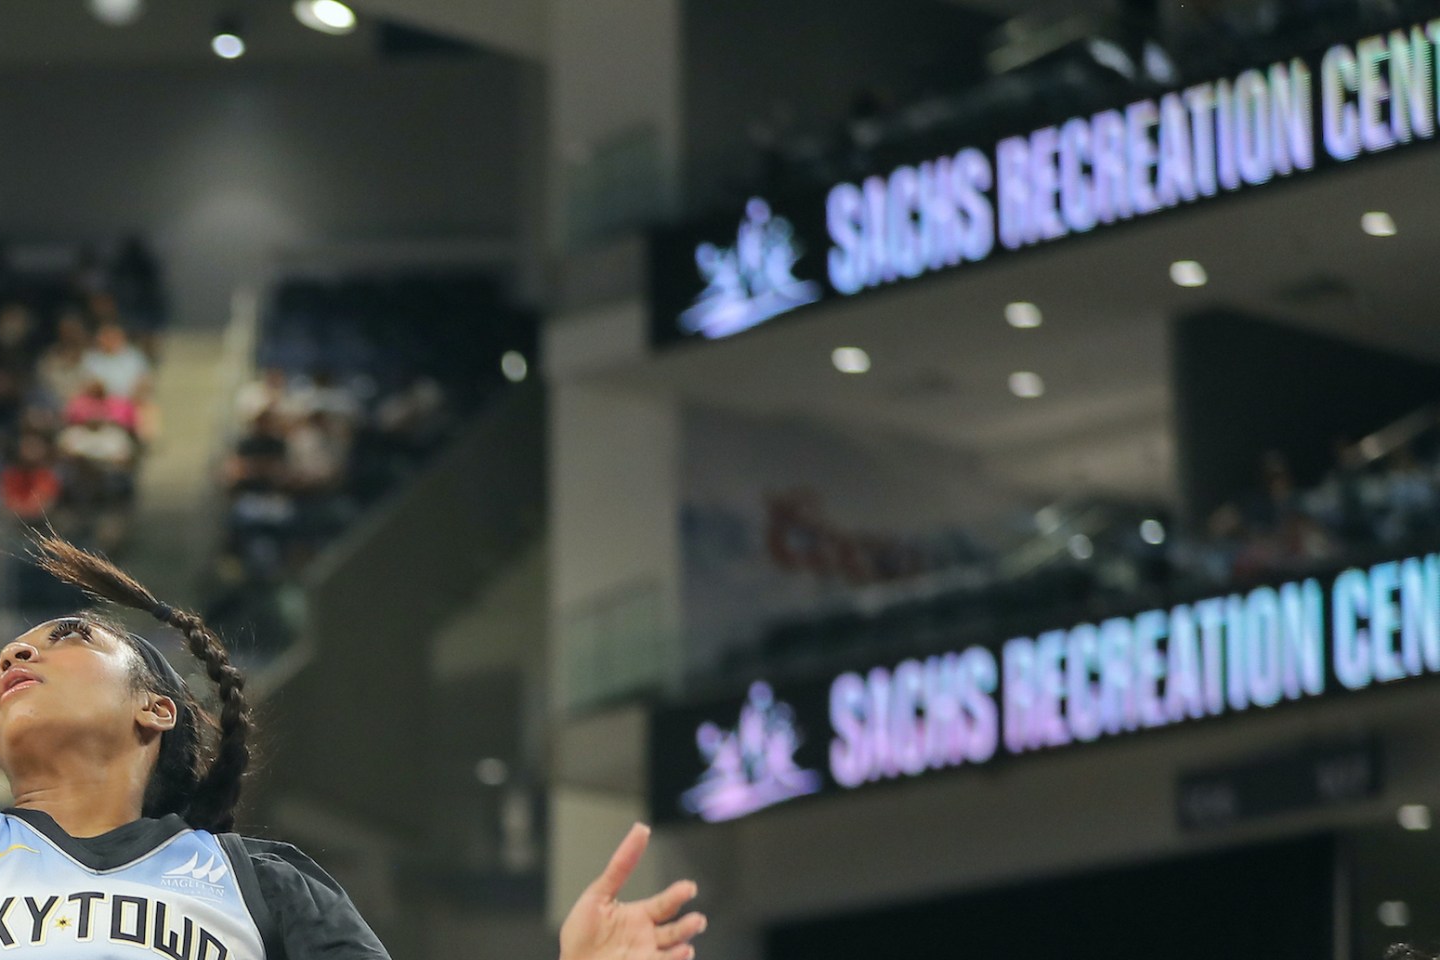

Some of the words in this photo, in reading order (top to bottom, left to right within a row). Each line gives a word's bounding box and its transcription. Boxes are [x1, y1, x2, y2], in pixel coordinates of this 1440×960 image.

[826, 147, 994, 296] SACHS
[996, 57, 1315, 251] RECREATION
[829, 645, 999, 788] SACHS
[1002, 577, 1325, 754] RECREATION
